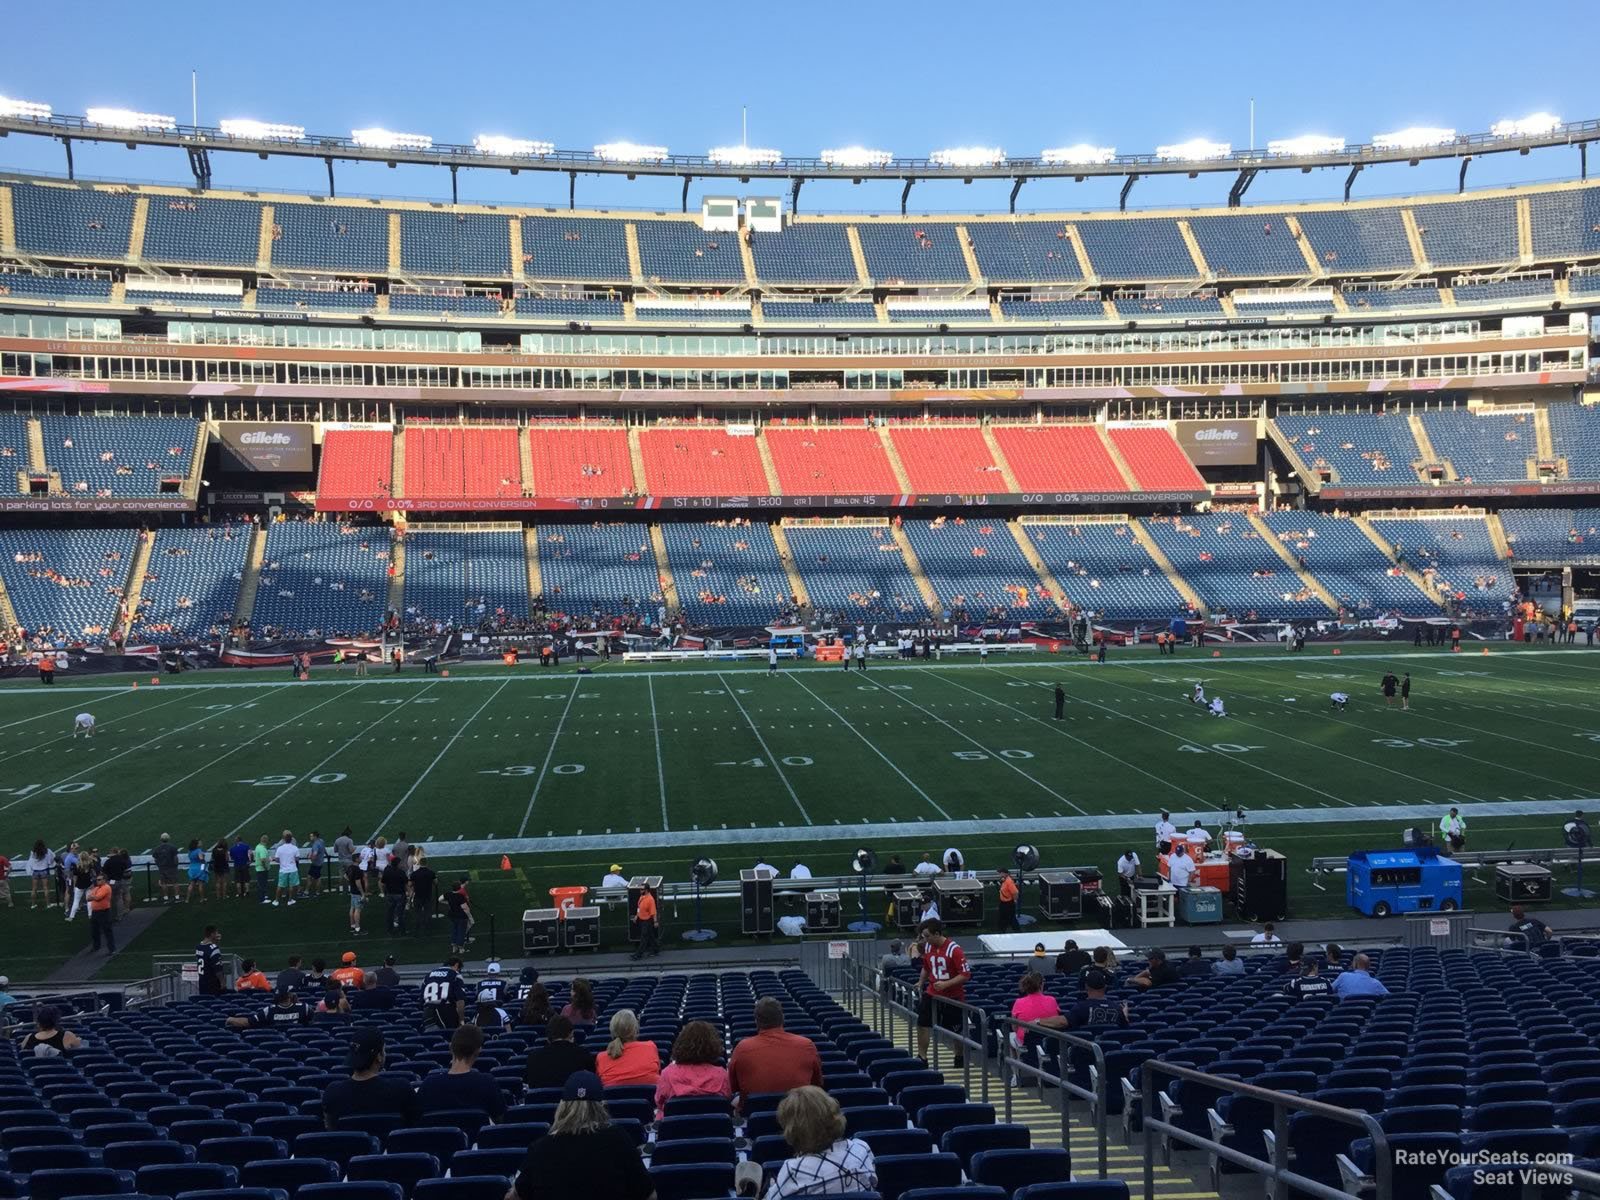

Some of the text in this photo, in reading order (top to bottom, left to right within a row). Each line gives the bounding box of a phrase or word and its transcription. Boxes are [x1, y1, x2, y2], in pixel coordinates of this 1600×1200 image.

[81, 344, 117, 352] BETTER
[121, 345, 179, 354] CONNECTED
[239, 430, 292, 445] Gillette
[1194, 428, 1239, 441] Gillette
[1354, 488, 1381, 498] proud
[1383, 487, 1393, 496] to
[1394, 487, 1428, 496] service
[1430, 487, 1448, 497] you
[1450, 487, 1462, 496] on
[1464, 487, 1489, 497] game
[1542, 484, 1575, 494] trucks
[1577, 483, 1595, 493] are
[673, 497, 689, 508] 1ST
[702, 497, 712, 507] 10
[757, 496, 782, 506] 15:00
[863, 495, 876, 505] 45
[1055, 492, 1193, 502] 0.0% 3RD DOWN CONVERSION
[6, 500, 49, 511] parking
[51, 501, 72, 509] lots
[75, 501, 92, 509] for
[95, 502, 120, 511] your
[122, 501, 190, 510] convenience.
[387, 500, 537, 509] 0.0% 3RD DOWN CONVERSION
[951, 749, 1035, 761] 50
[739, 755, 814, 768] 40
[500, 763, 586, 776] 30
[252, 772, 348, 786] 20
[8, 782, 96, 796] 10
[929, 955, 950, 980] 12
[429, 970, 449, 978] MOSS
